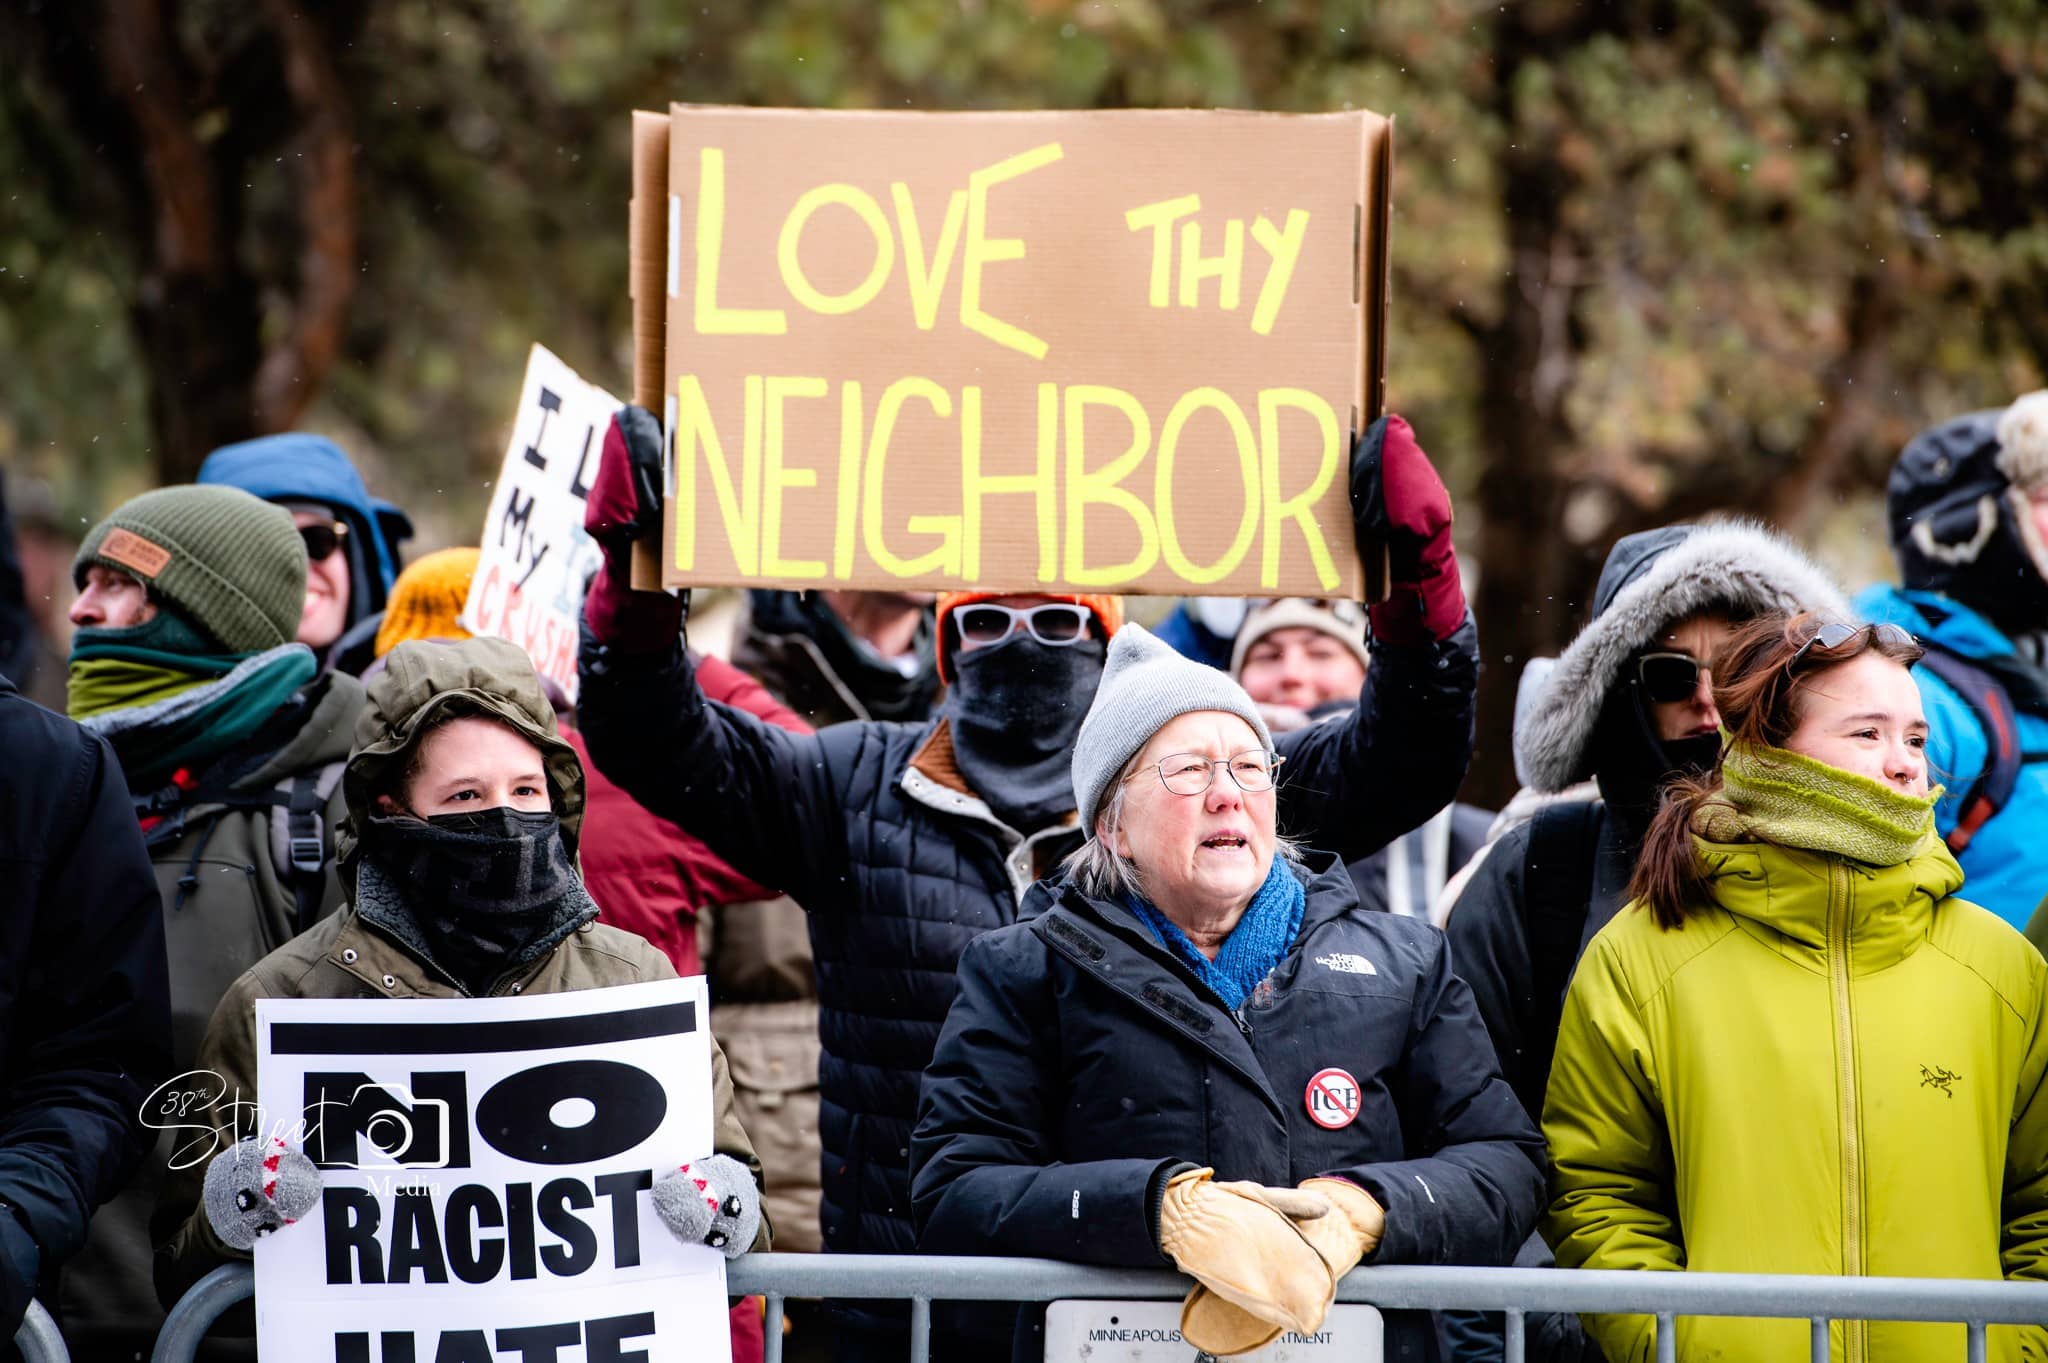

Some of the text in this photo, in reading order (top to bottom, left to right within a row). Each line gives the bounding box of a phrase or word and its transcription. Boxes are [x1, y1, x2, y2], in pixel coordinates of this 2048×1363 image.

[694, 142, 1310, 360] LOVE THY
[524, 386, 562, 472] I
[675, 374, 1342, 590] NEIGHBOR
[303, 1059, 667, 1170] NO
[1313, 1088, 1358, 1111] ICE
[322, 1169, 653, 1285] RACIST
[1089, 1329, 1182, 1342] MINNEAPOLIS
